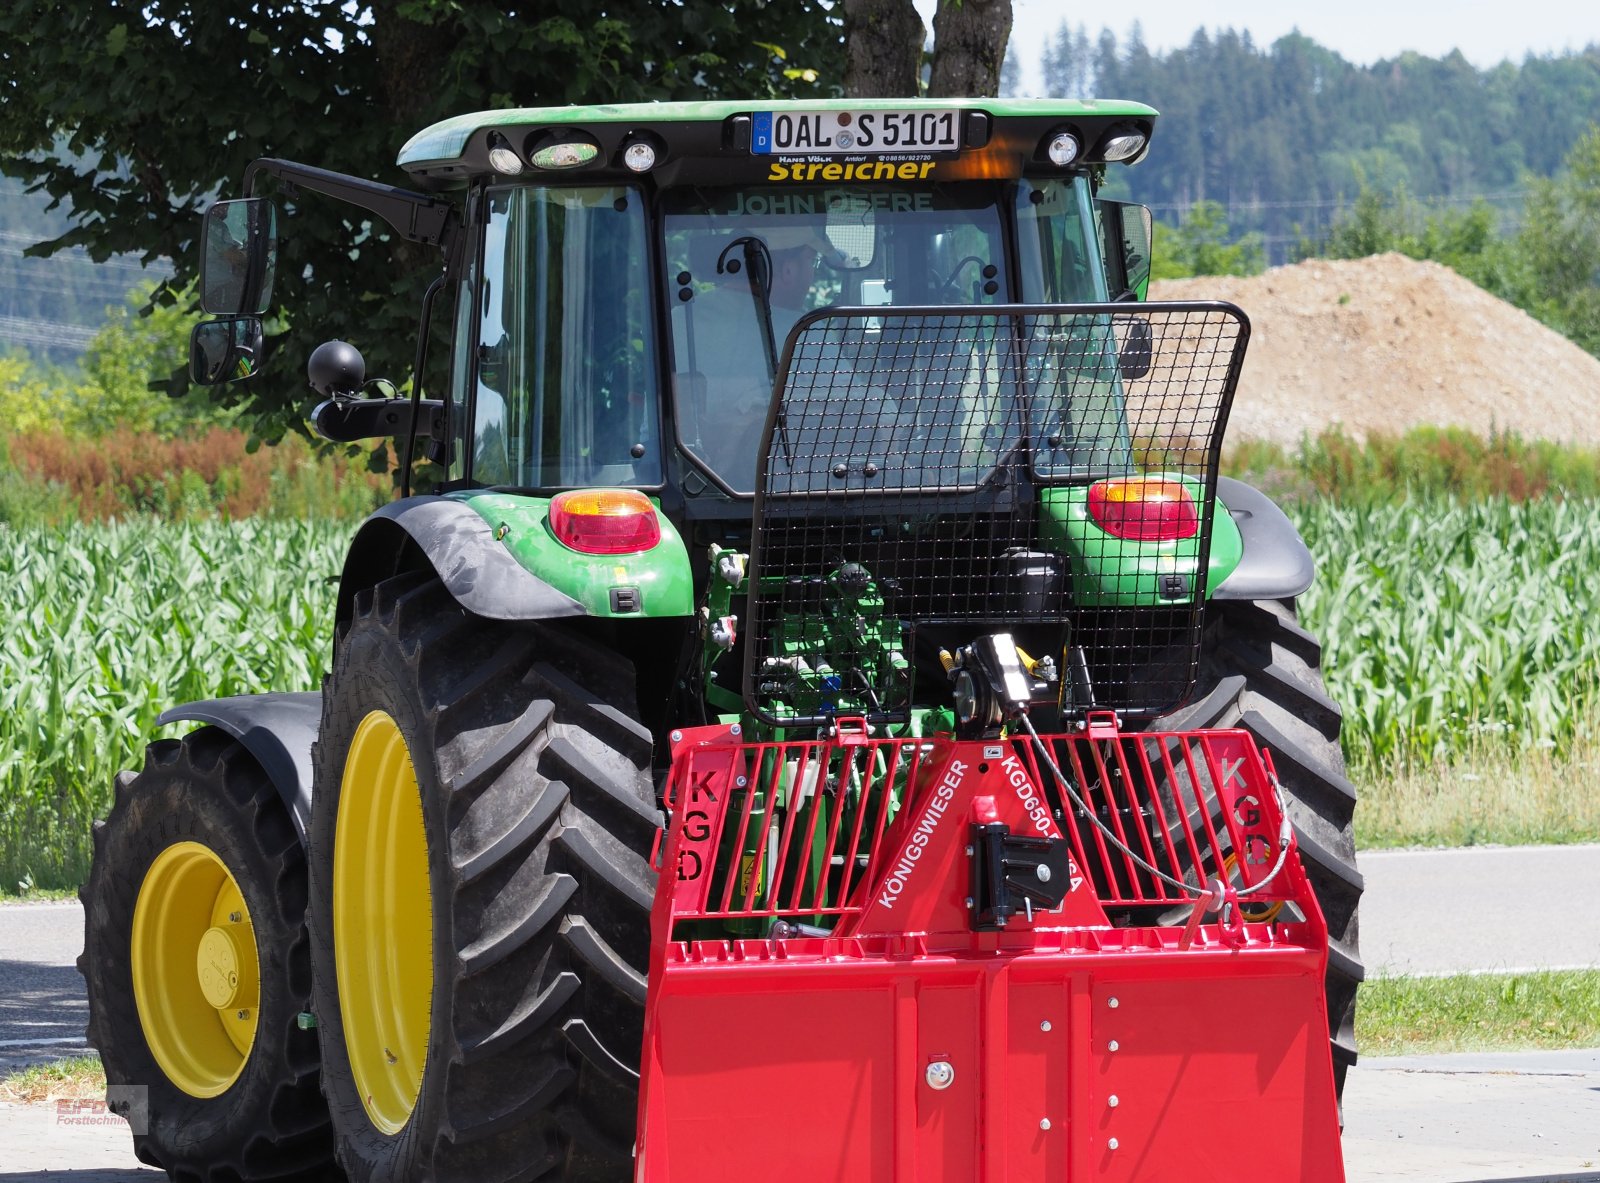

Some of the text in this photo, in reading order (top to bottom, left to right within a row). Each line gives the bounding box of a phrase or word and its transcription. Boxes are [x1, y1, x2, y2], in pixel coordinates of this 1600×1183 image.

[758, 136, 766, 146] D
[775, 112, 955, 148] OAL S 5101
[768, 161, 936, 180] Streicher
[728, 190, 934, 216] JOHN DEERE
[878, 759, 968, 909] KÖNIGSWIESER
